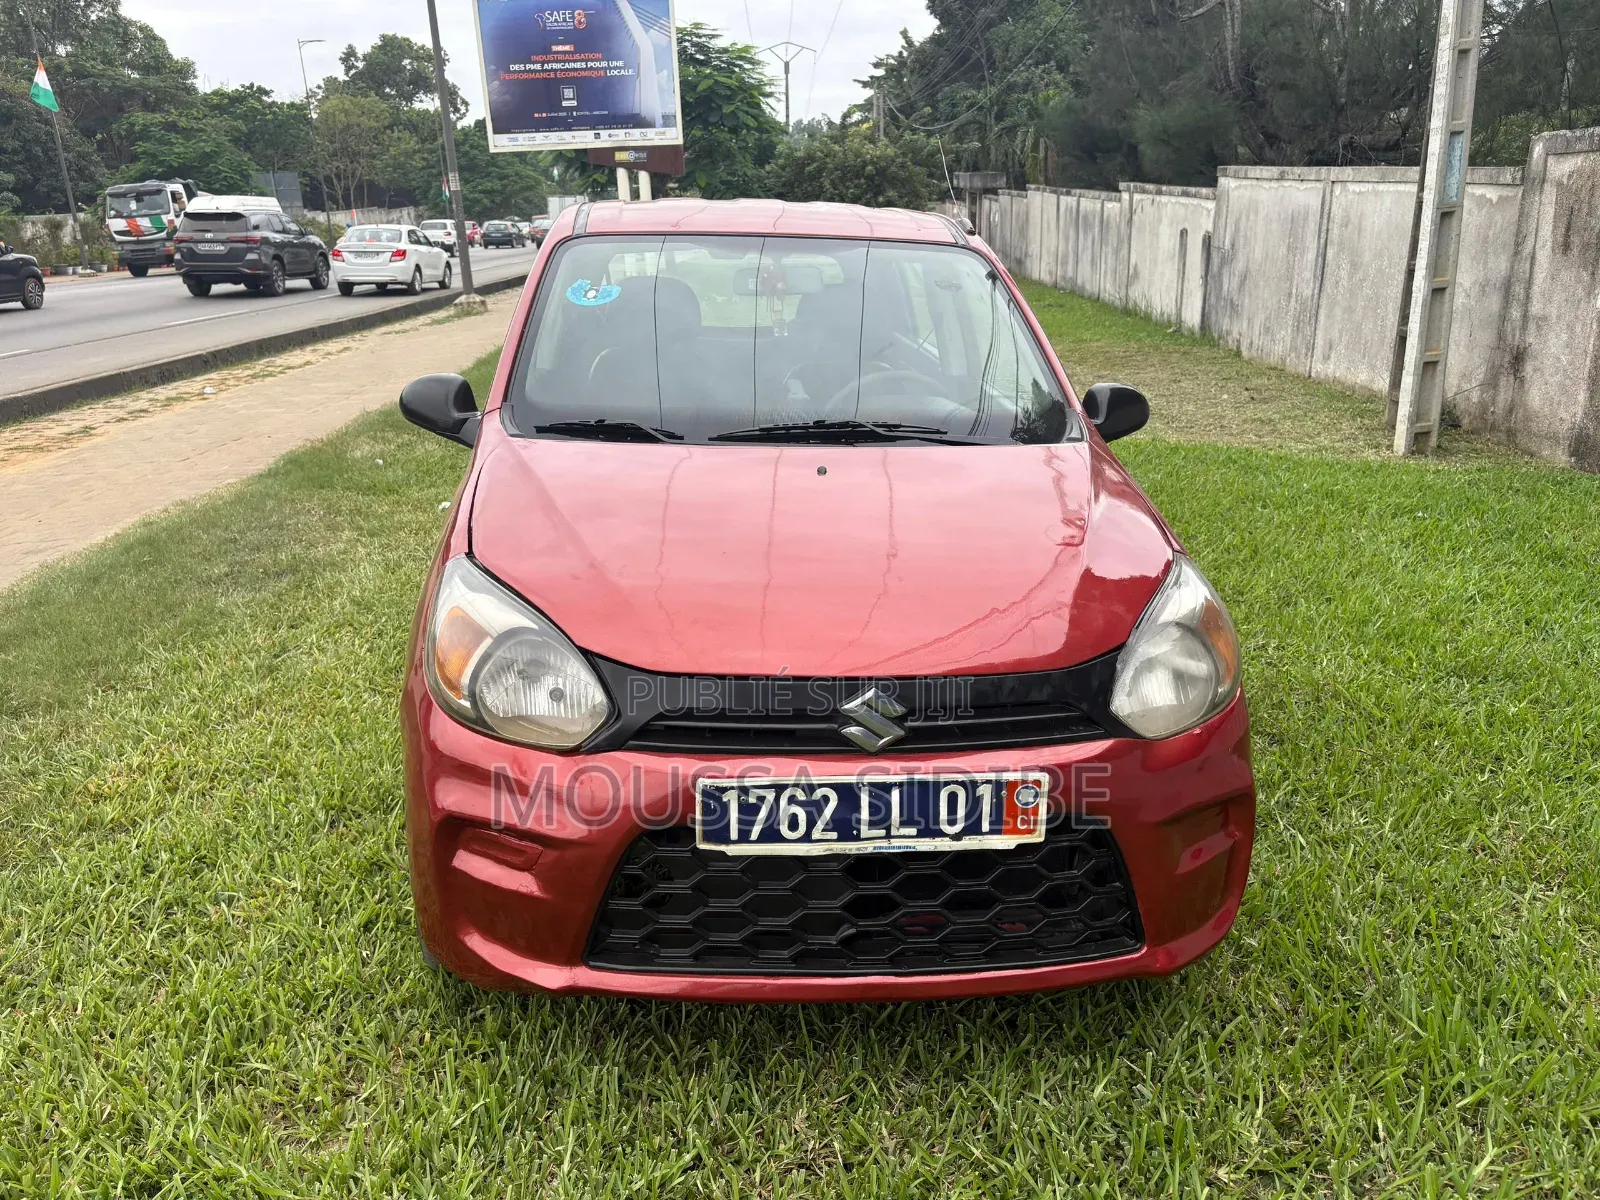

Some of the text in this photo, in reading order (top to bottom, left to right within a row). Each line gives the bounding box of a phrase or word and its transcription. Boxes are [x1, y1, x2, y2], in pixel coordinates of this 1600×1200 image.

[545, 11, 573, 22] SAFE
[531, 53, 602, 61] INDUSTRIALISATION
[543, 61, 586, 70] AFRICAINES
[500, 71, 556, 80] PERFORMANCE
[557, 69, 605, 78] ÉCONOMIQUE
[722, 784, 992, 841] 1762 LL 01
[1016, 815, 1034, 830] CI
